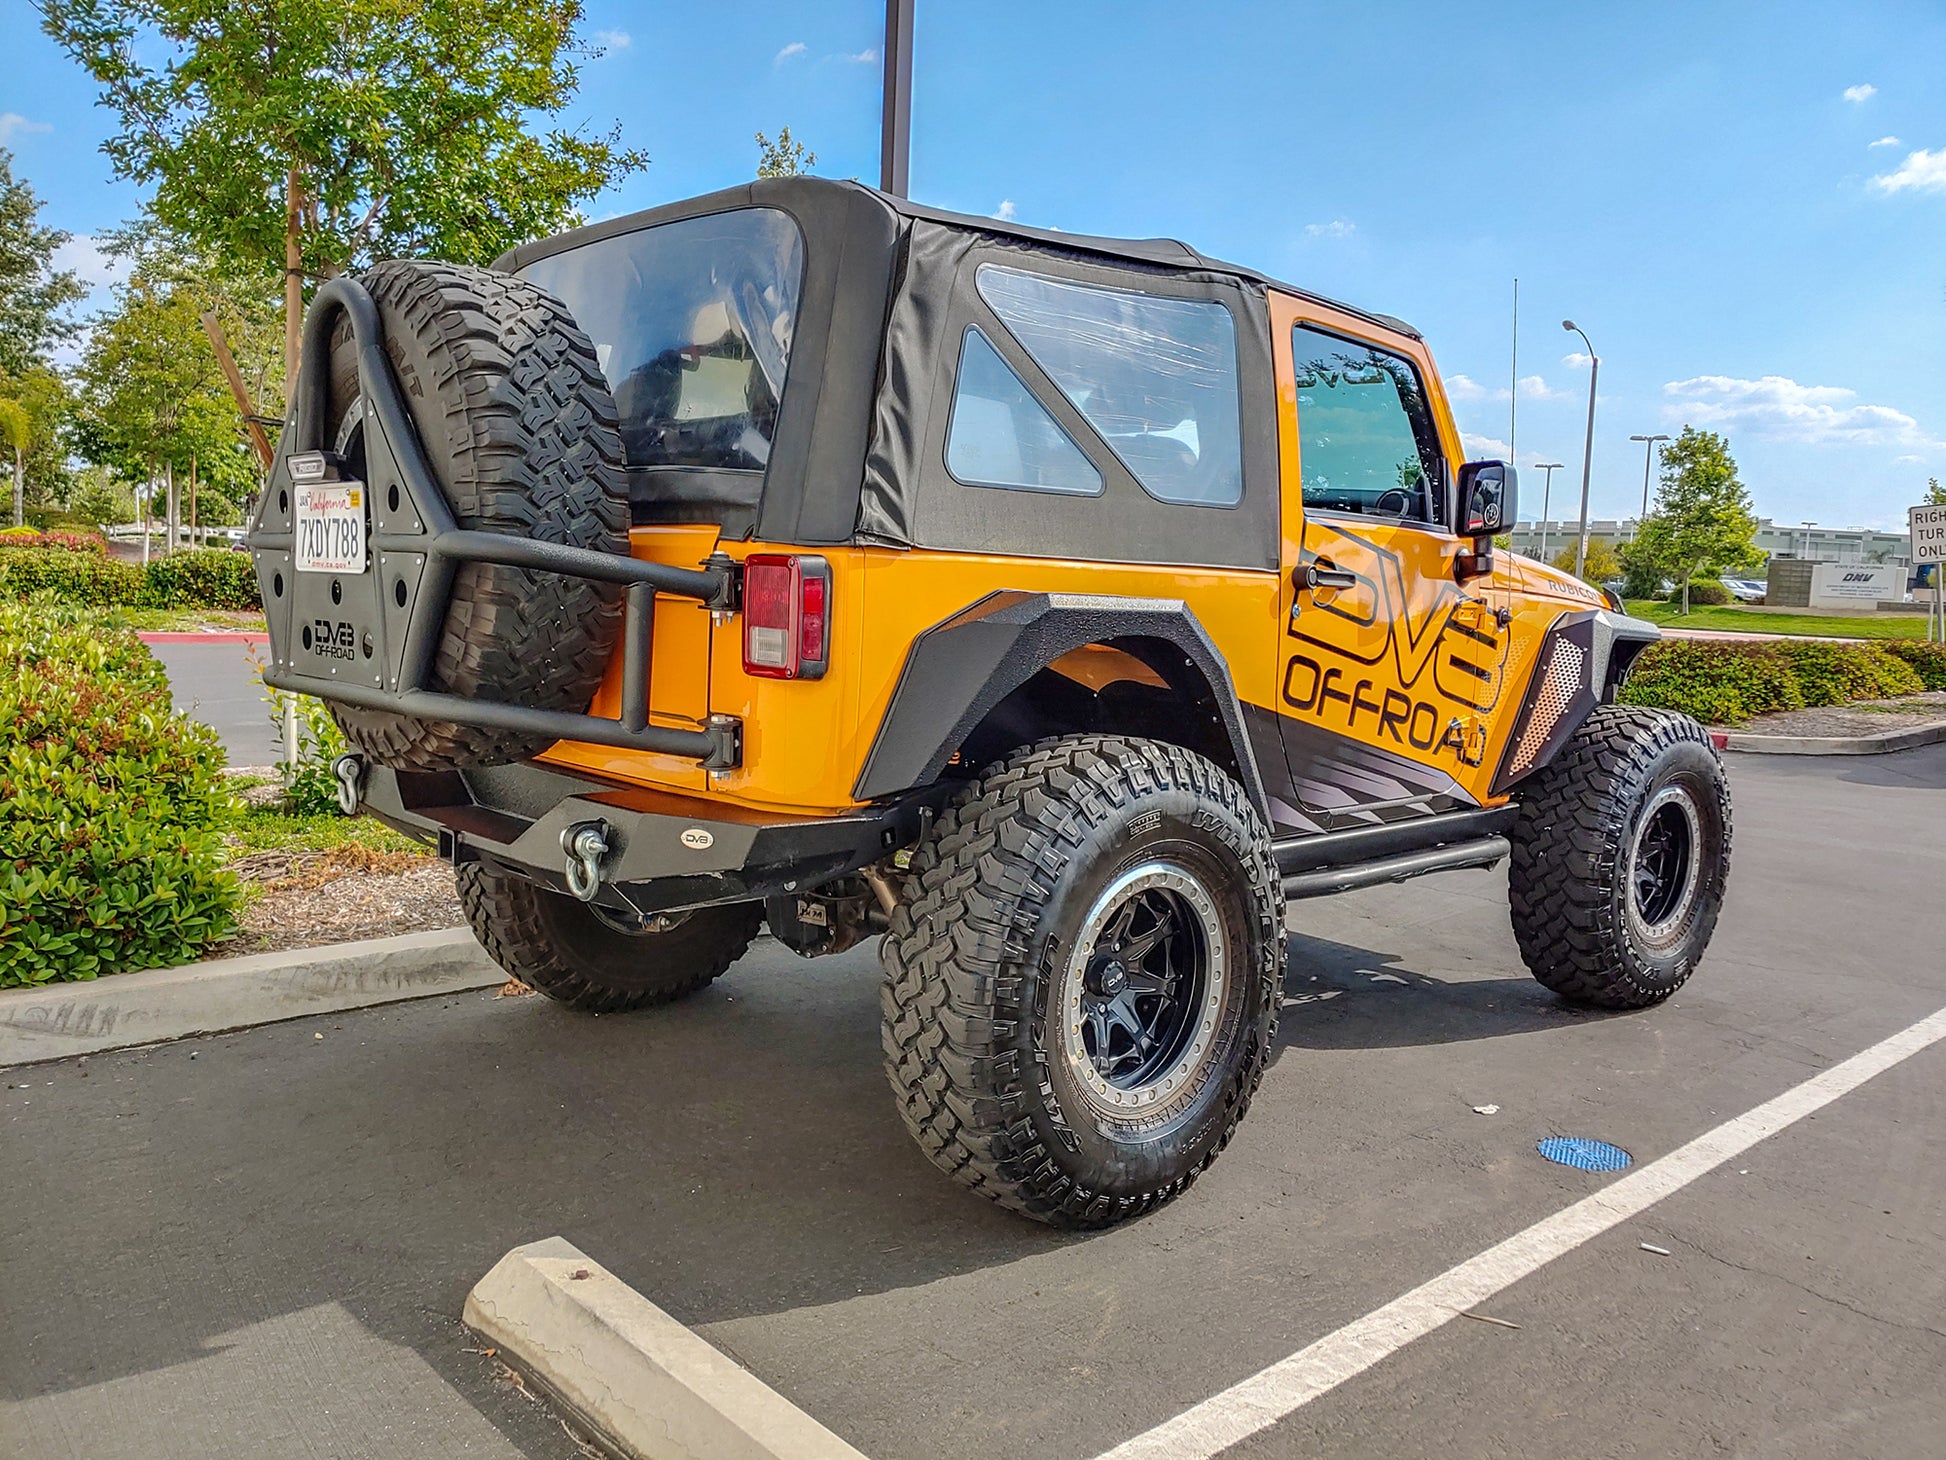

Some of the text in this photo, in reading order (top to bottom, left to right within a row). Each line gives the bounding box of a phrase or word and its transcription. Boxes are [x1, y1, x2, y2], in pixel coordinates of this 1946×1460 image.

[309, 490, 352, 518] California
[300, 517, 359, 559] 7XDY788
[1918, 545, 1946, 557] ONL
[311, 561, 348, 569] dmv.ca.gov
[1842, 573, 1874, 582] DMV
[1547, 579, 1600, 601] RUBICON
[1287, 516, 1511, 714] DV8
[315, 619, 355, 647] DV8
[685, 834, 709, 844] DV8
[1191, 808, 1276, 1012] WILDPEAK
